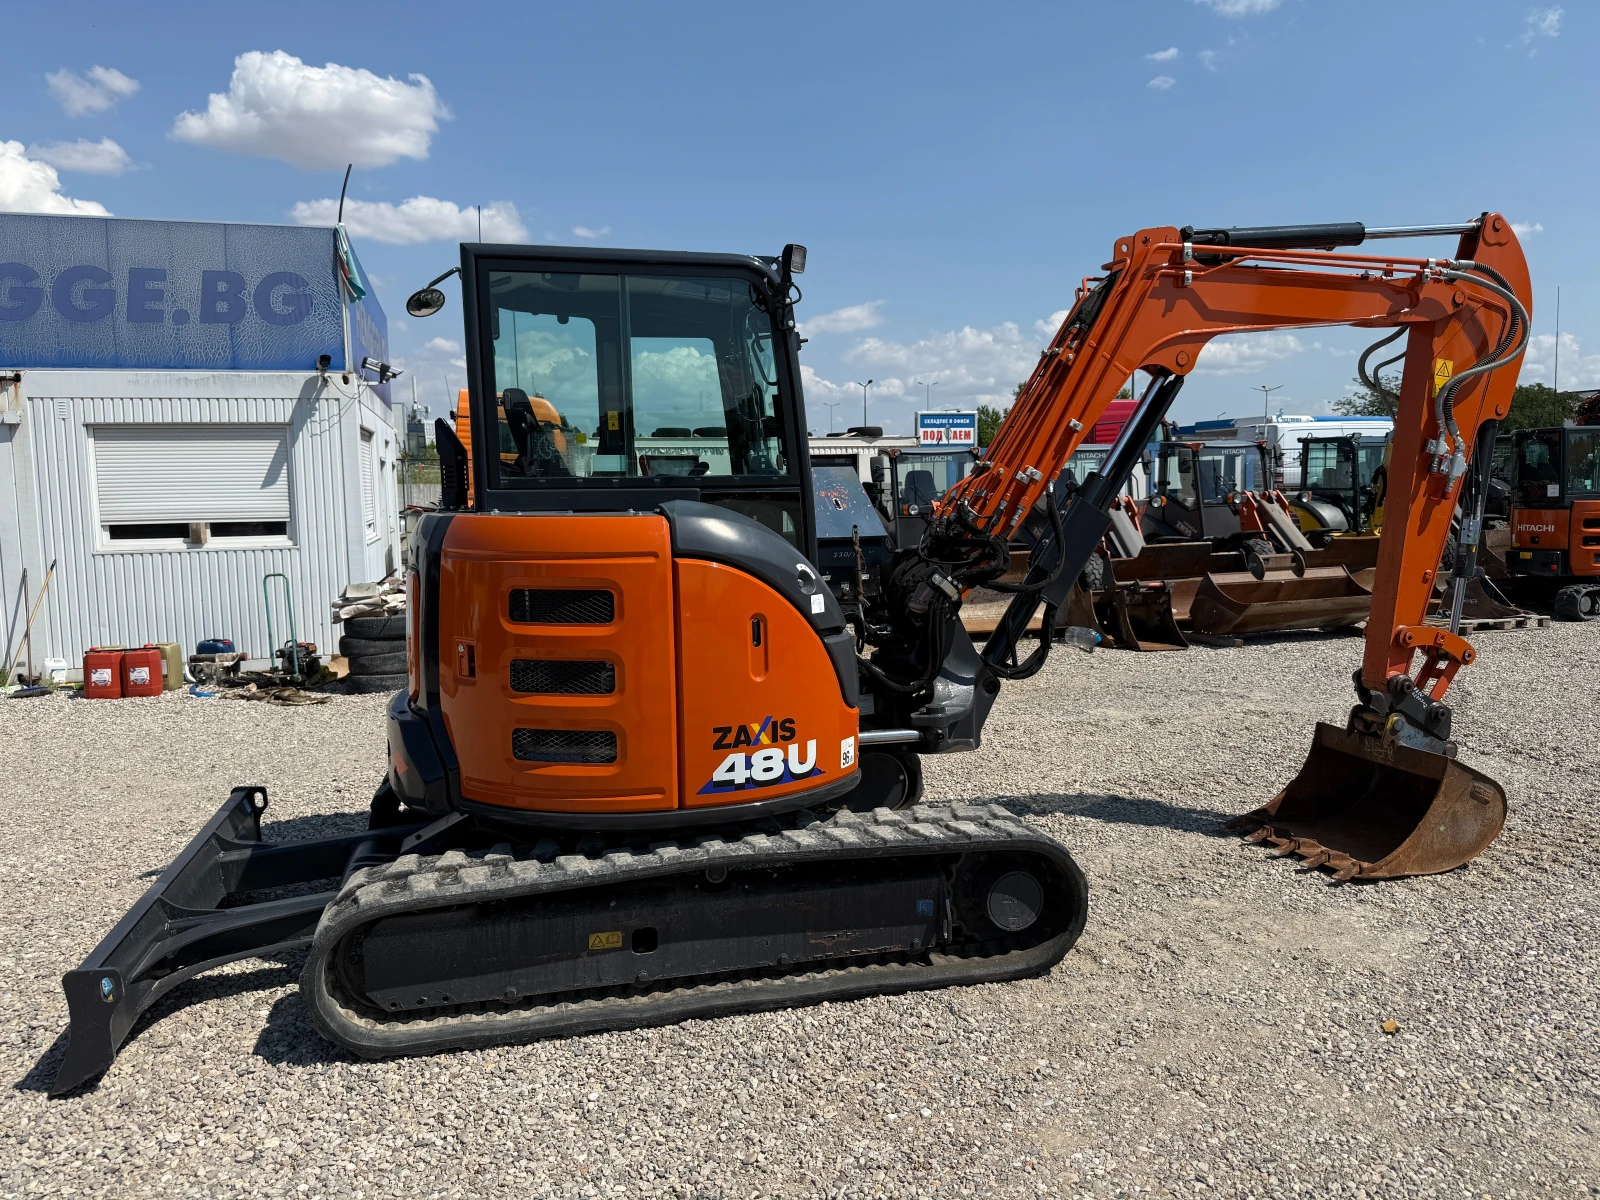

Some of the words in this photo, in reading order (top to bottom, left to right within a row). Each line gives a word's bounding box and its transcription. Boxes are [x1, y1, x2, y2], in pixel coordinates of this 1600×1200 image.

[922, 430, 943, 442] ПОД
[945, 430, 971, 441] АЕМ
[1517, 524, 1555, 532] HITACHI
[712, 715, 796, 750] ZAXIS
[712, 738, 817, 788] 48U
[842, 750, 850, 766] 96
